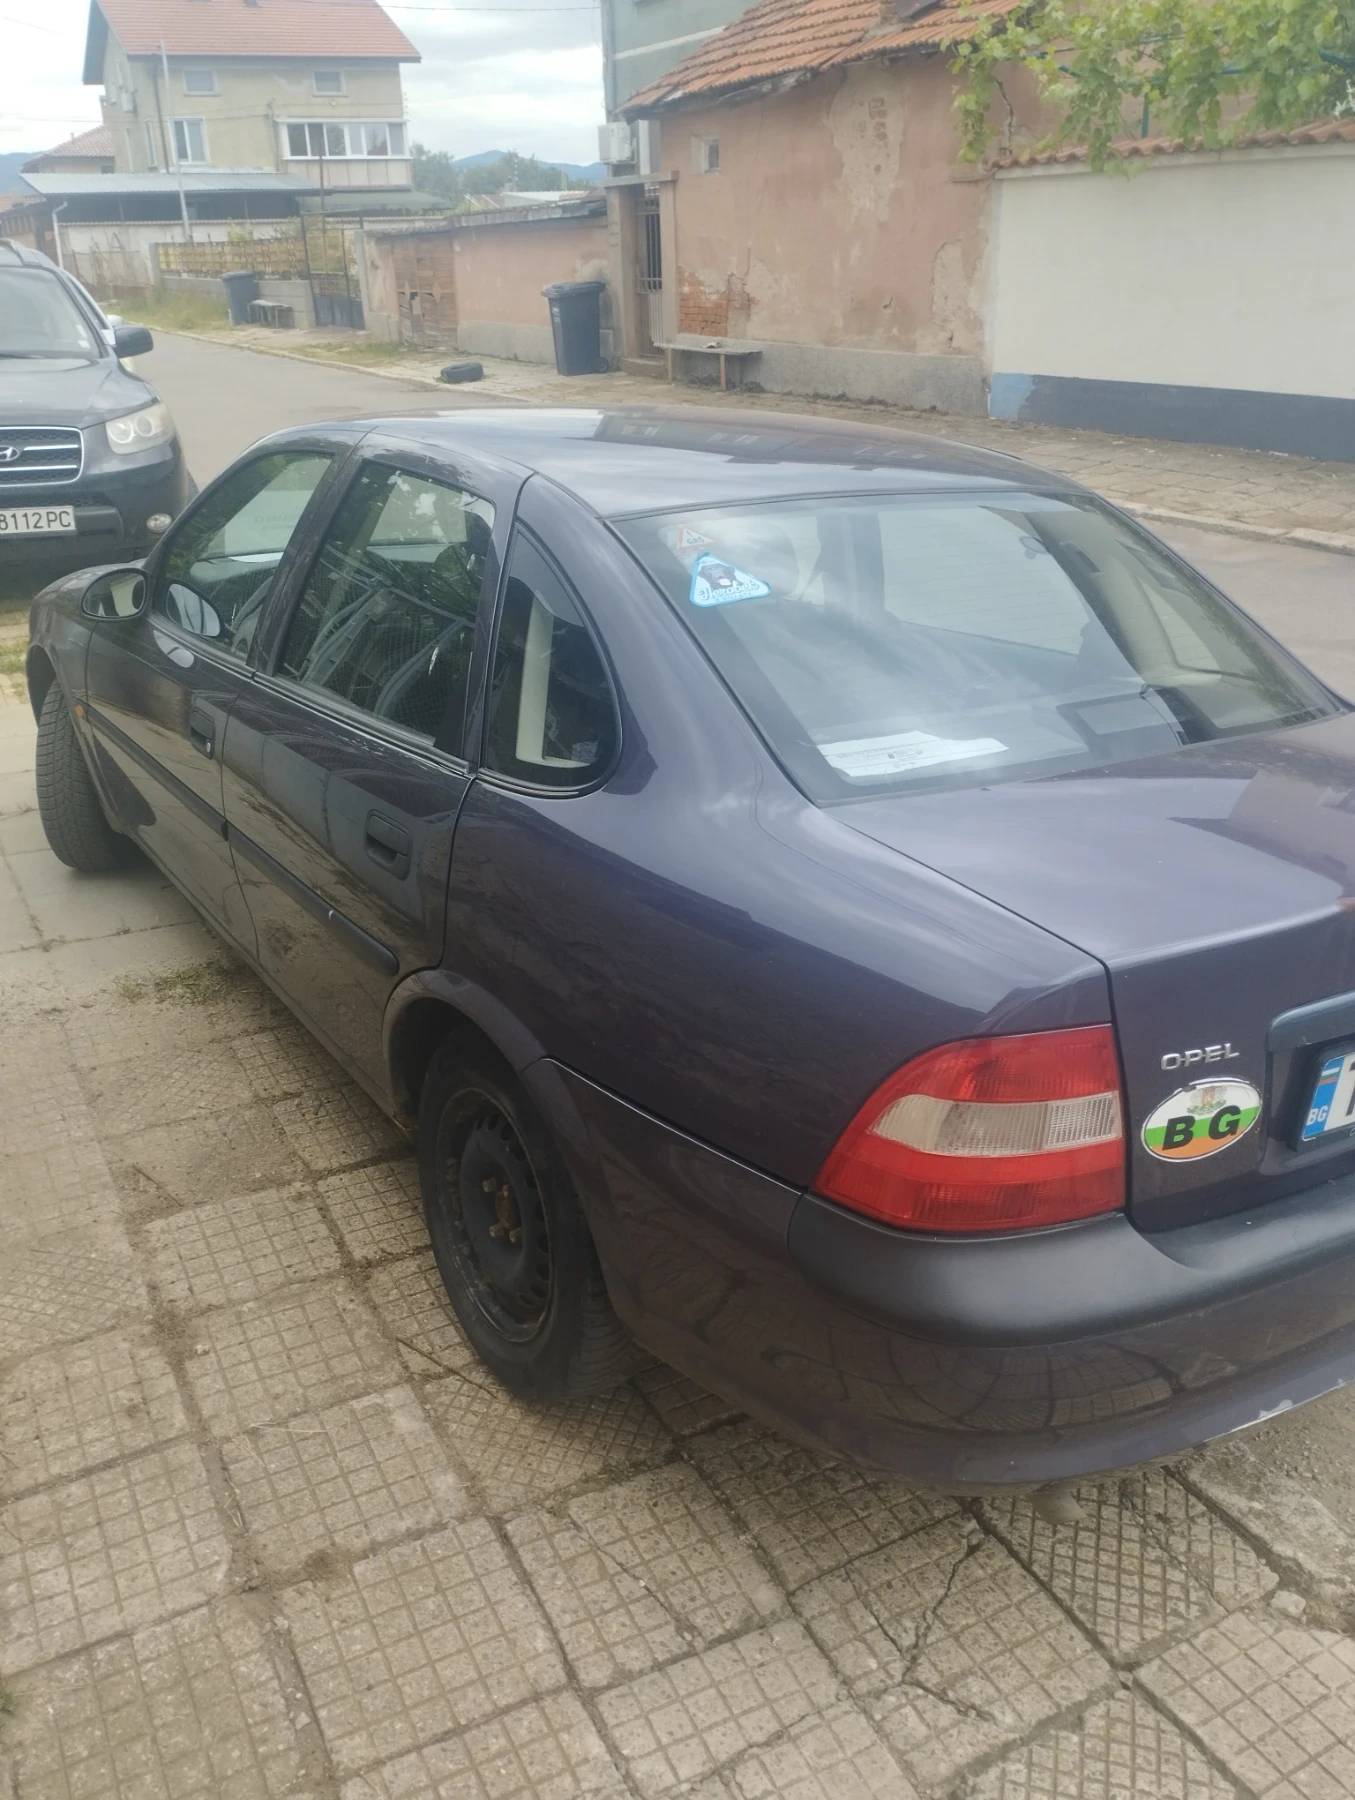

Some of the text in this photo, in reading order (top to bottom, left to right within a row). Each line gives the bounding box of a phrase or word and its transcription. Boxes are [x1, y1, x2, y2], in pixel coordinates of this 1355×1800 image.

[686, 536, 705, 545] GAS
[1160, 1043, 1240, 1070] OPEL
[1306, 1105, 1328, 1126] BG
